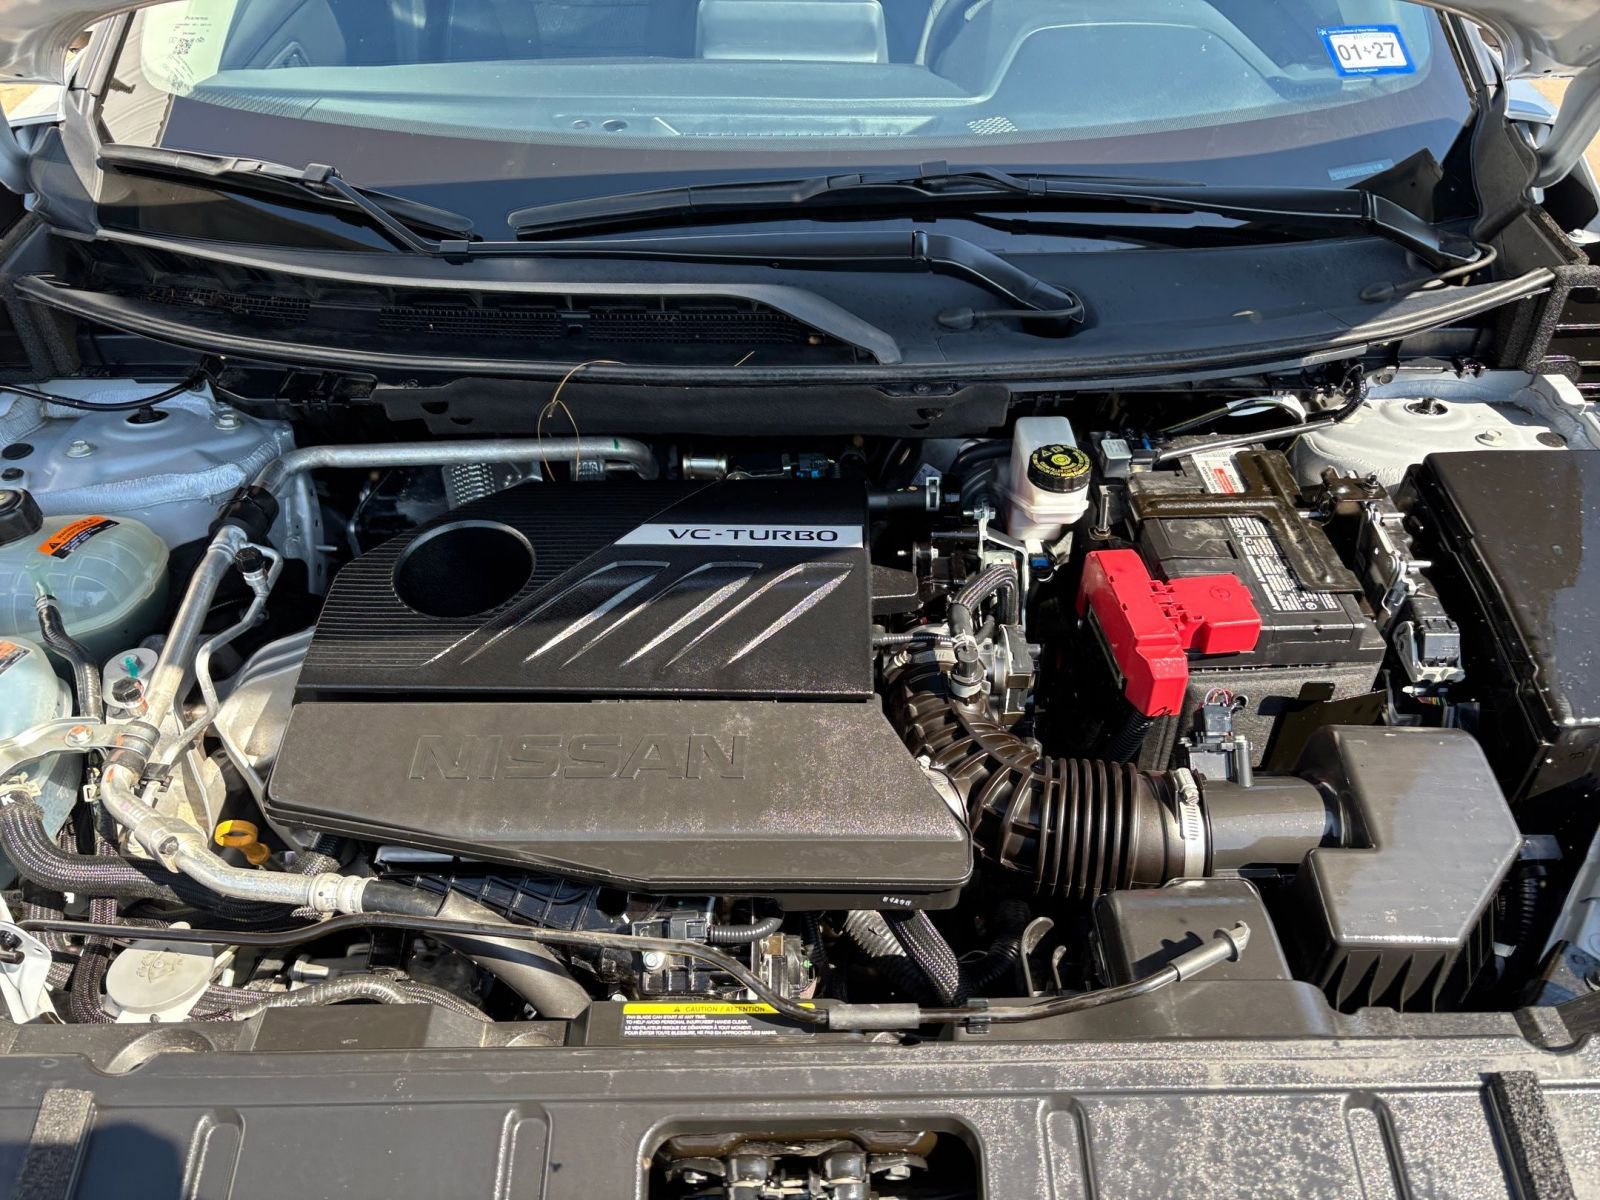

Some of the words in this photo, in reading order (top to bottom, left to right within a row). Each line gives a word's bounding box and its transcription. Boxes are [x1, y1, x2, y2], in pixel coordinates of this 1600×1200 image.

[1337, 44, 1362, 61] 01
[1371, 41, 1395, 60] 27
[667, 527, 839, 543] VC-TURBO
[408, 732, 749, 780] NISSAN
